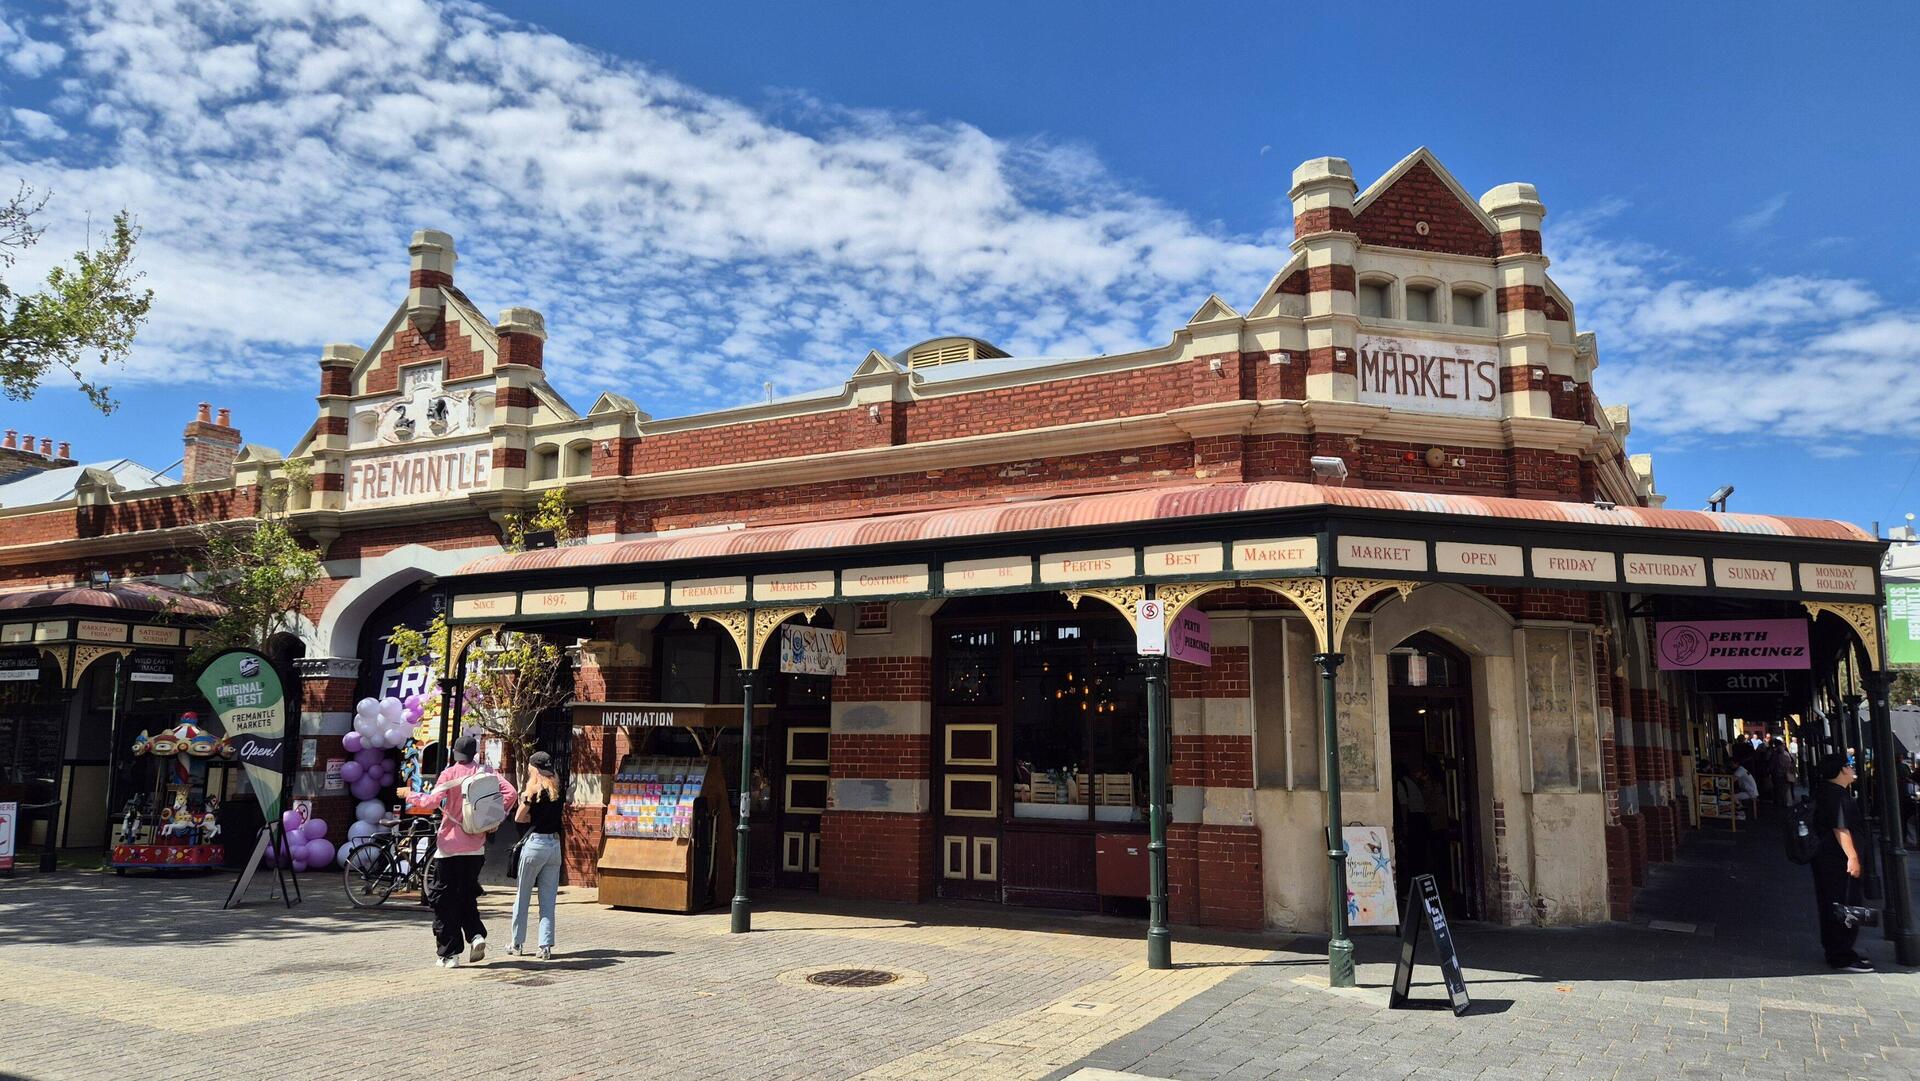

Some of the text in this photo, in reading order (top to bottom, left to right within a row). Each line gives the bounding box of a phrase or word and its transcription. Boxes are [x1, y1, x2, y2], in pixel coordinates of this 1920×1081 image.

[1360, 350, 1496, 402] MARKETS
[349, 450, 491, 502] FREMANTLE
[1351, 545, 1777, 582] MARKET OPEN FRIDAY SATURDAY SUNDAY
[682, 585, 735, 597] FREMANTLE
[770, 580, 817, 593] MARKETS
[859, 574, 909, 587] CONTINUE
[962, 569, 975, 580] TO
[998, 567, 1013, 577] BE
[1063, 559, 1112, 573] PERTH'S
[1165, 552, 1200, 566] BEST
[1244, 548, 1305, 561] MARKET
[1815, 567, 1855, 578] MONDAY
[1816, 579, 1858, 590] HOLIDAY
[1708, 631, 1768, 642] PERTH
[1709, 646, 1805, 657] PIERCINGZ
[216, 681, 263, 698] ORIGINAL
[235, 692, 263, 706] BEST
[231, 709, 276, 723] FREMANTLE
[602, 711, 674, 727] INFORMATION
[236, 718, 272, 731] MARKETS
[240, 740, 282, 760] Open!
